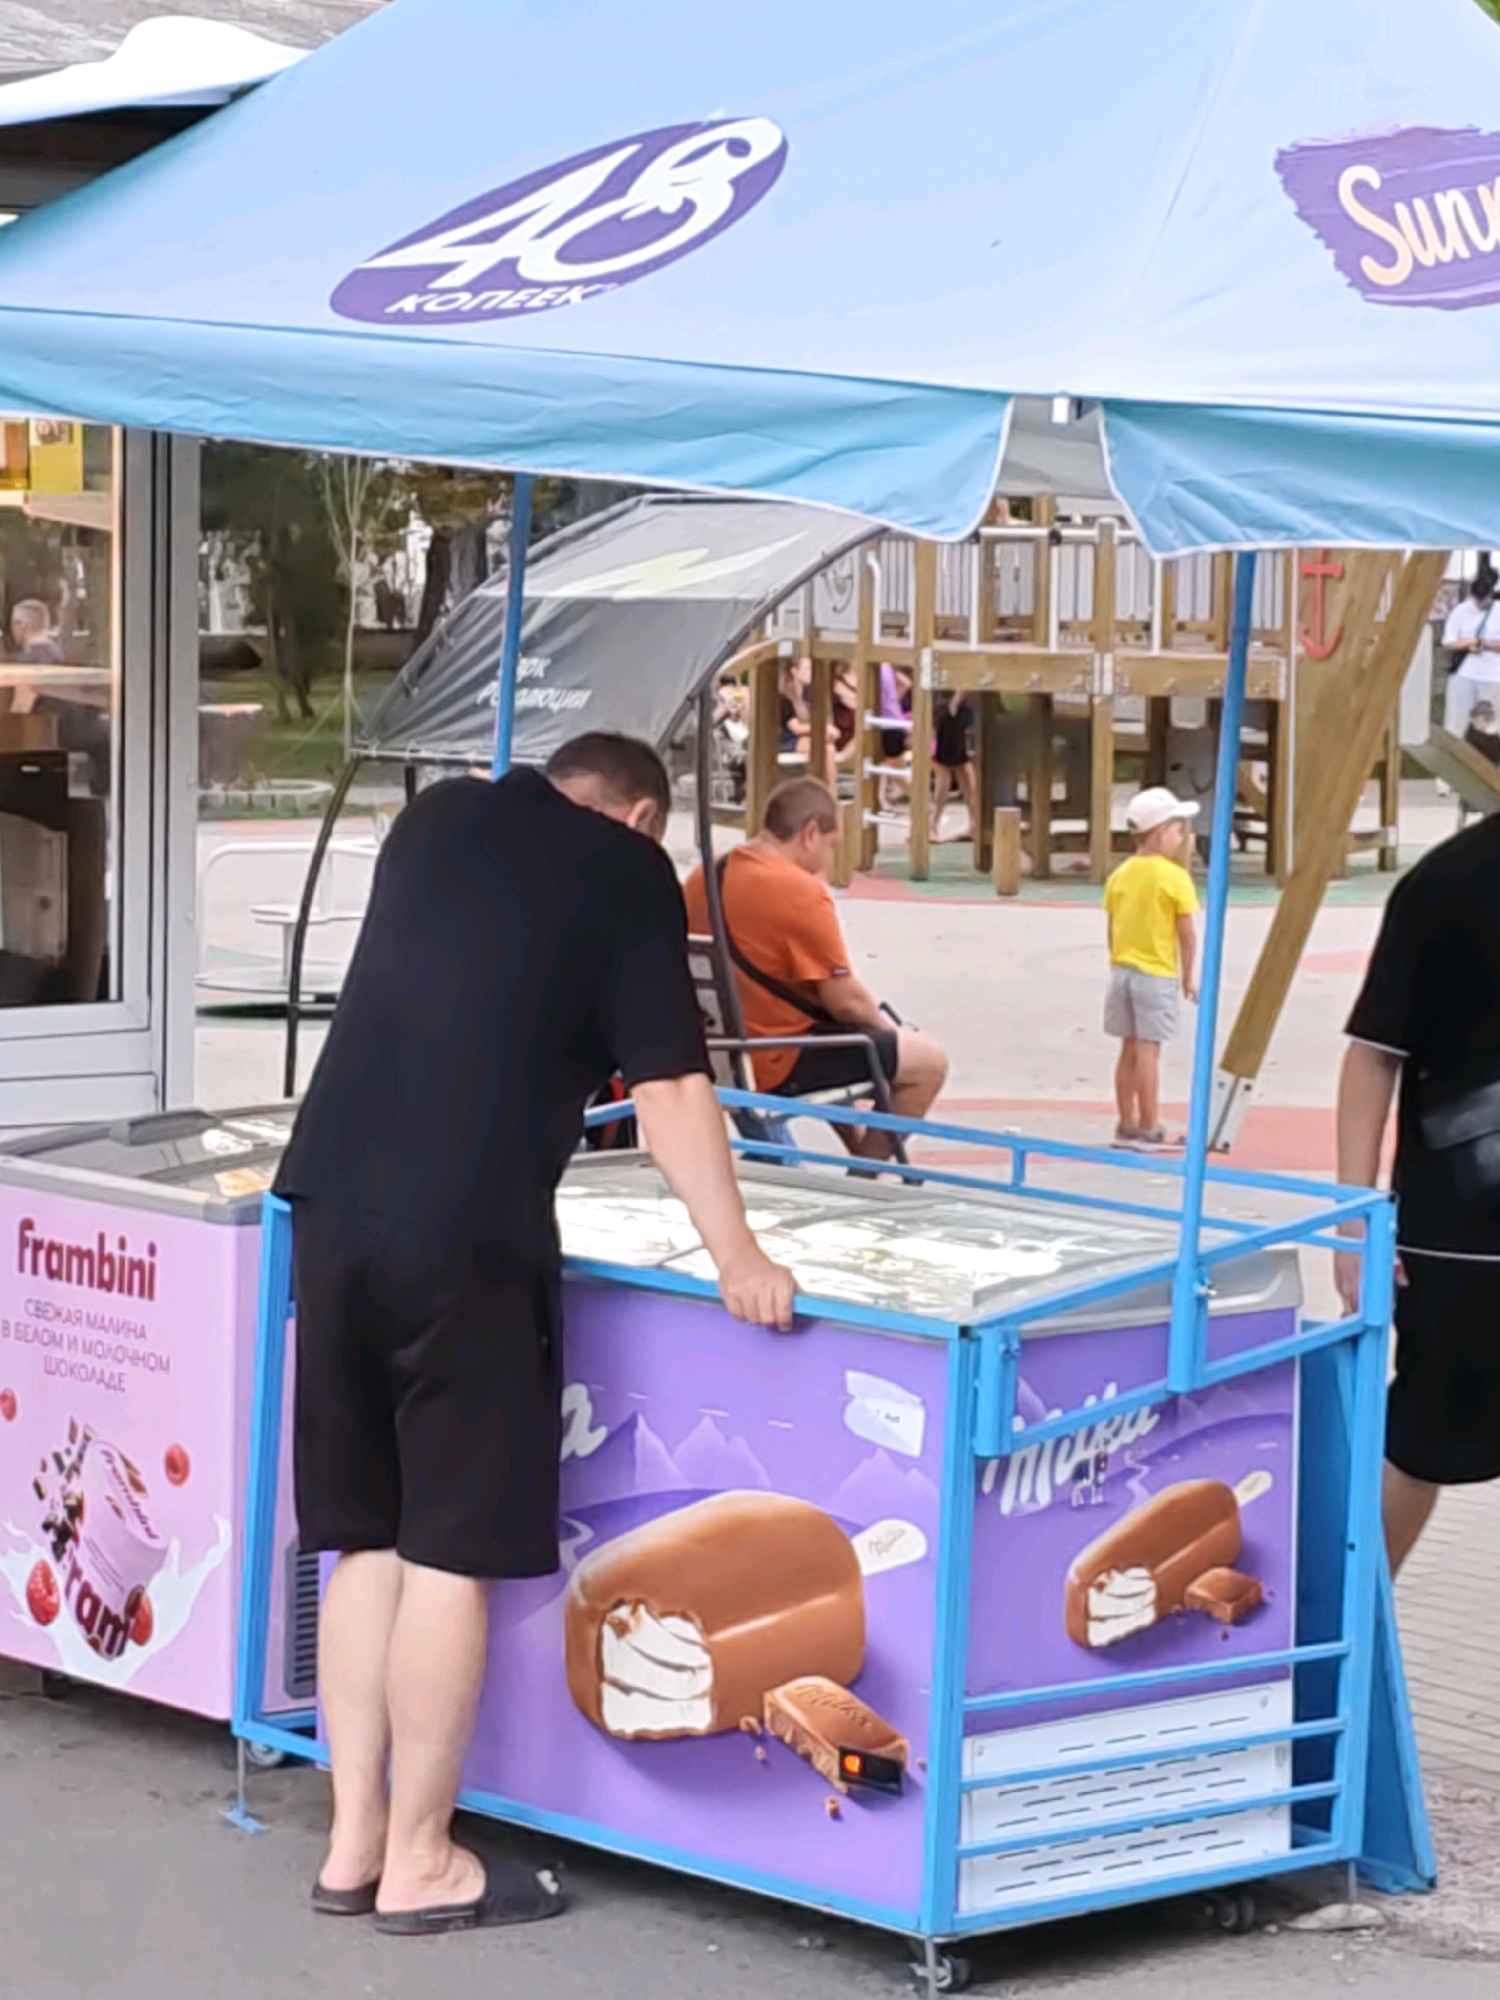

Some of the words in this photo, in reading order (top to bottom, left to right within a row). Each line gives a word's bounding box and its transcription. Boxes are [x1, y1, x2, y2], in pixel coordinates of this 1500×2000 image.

[357, 116, 783, 290] 48
[384, 284, 602, 314] КОПЕЕК
[18, 1217, 156, 1302] frambini
[24, 1298, 83, 1328] СВЕЖАЯ
[86, 1311, 147, 1341] МАЛИНА
[2, 1319, 11, 1338] В
[14, 1321, 63, 1350] БЕЛОМ
[67, 1333, 78, 1353] И
[82, 1338, 170, 1375] МОЛОЧНОМ
[44, 1355, 126, 1393] ШОКОЛАДЕ
